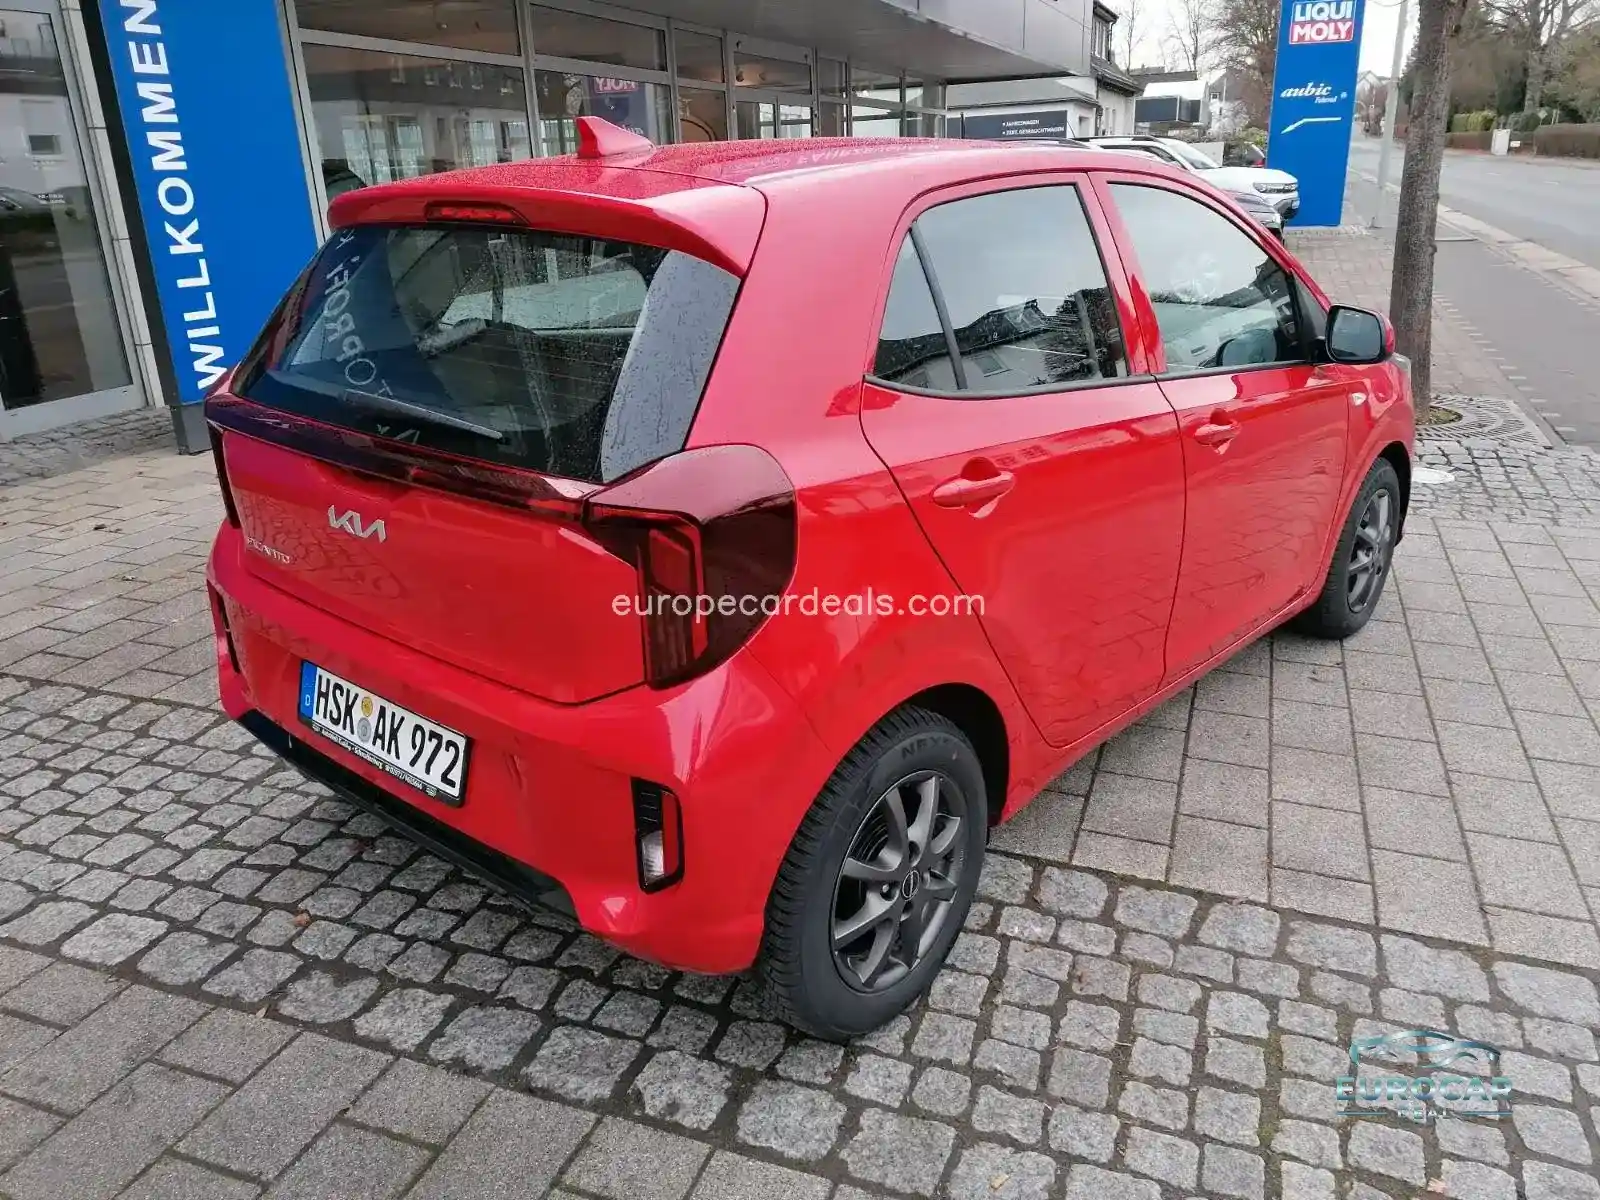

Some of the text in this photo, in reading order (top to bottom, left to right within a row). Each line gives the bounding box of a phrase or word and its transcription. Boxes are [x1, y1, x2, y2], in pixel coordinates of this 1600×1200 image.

[1294, 1, 1353, 21] LIQUI
[1291, 21, 1352, 42] MOLY
[119, 0, 230, 390] WILLKOMMEN
[327, 504, 387, 544] KIA
[315, 674, 359, 735] HSK
[372, 705, 405, 761] AK
[409, 723, 461, 789] 972
